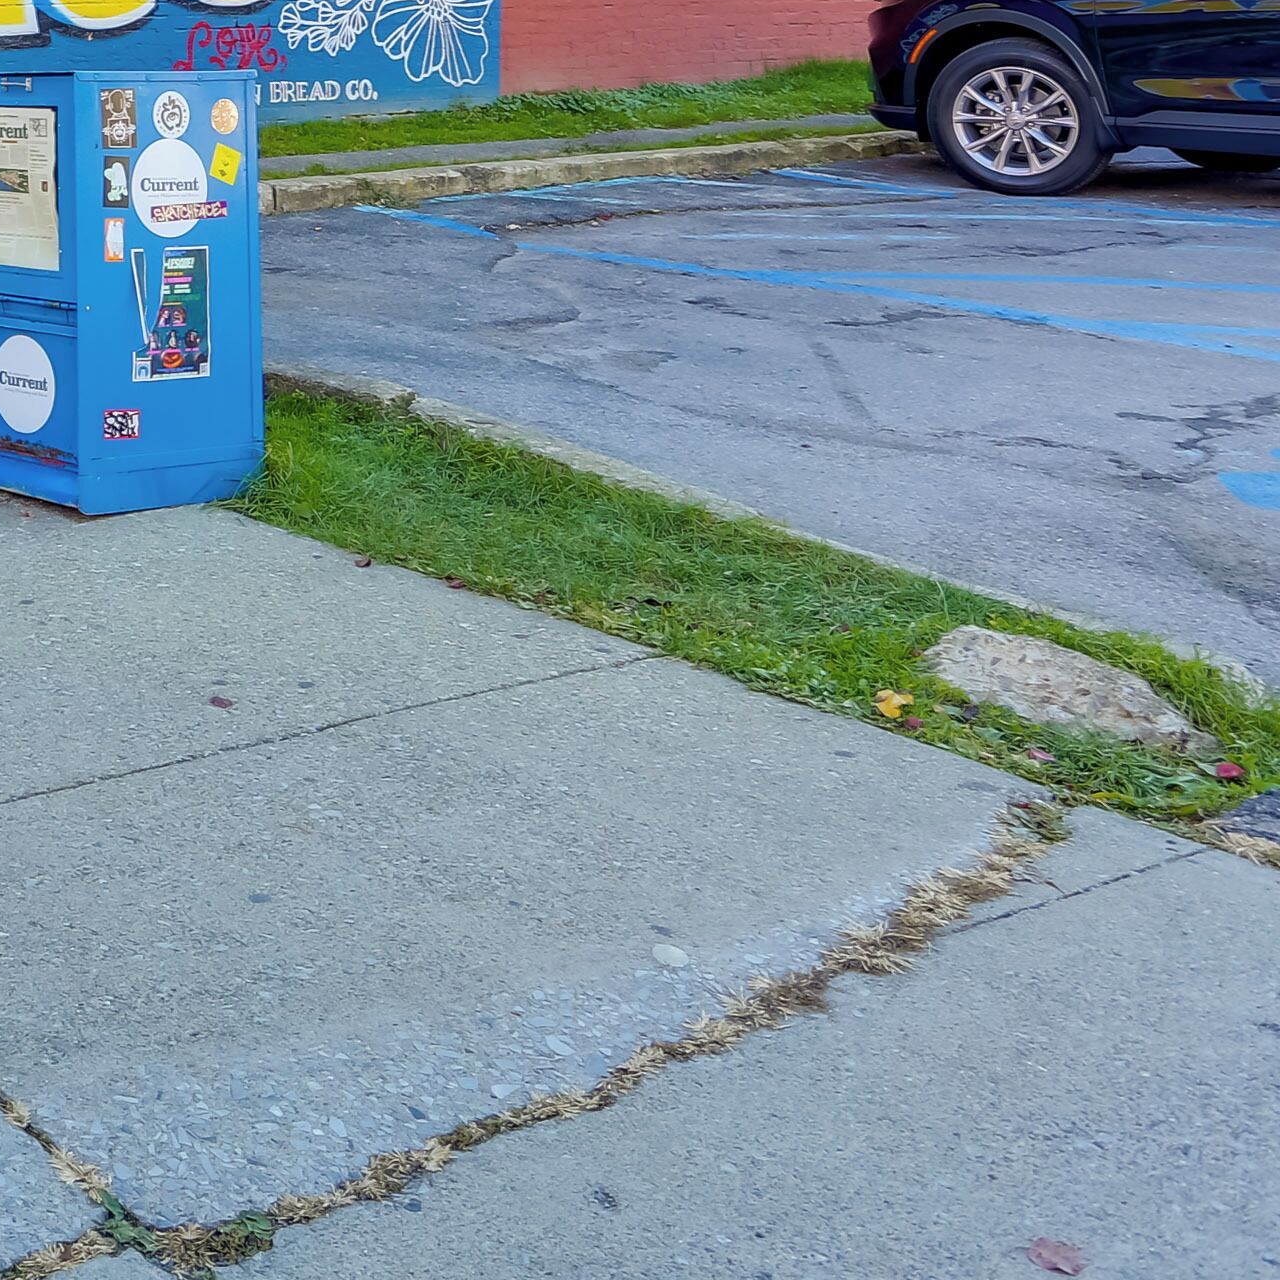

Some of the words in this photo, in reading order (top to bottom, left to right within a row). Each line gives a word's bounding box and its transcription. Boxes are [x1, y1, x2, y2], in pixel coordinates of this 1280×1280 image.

[269, 80, 341, 103] BREAD
[345, 78, 379, 101] CO.
[140, 177, 199, 192] Current
